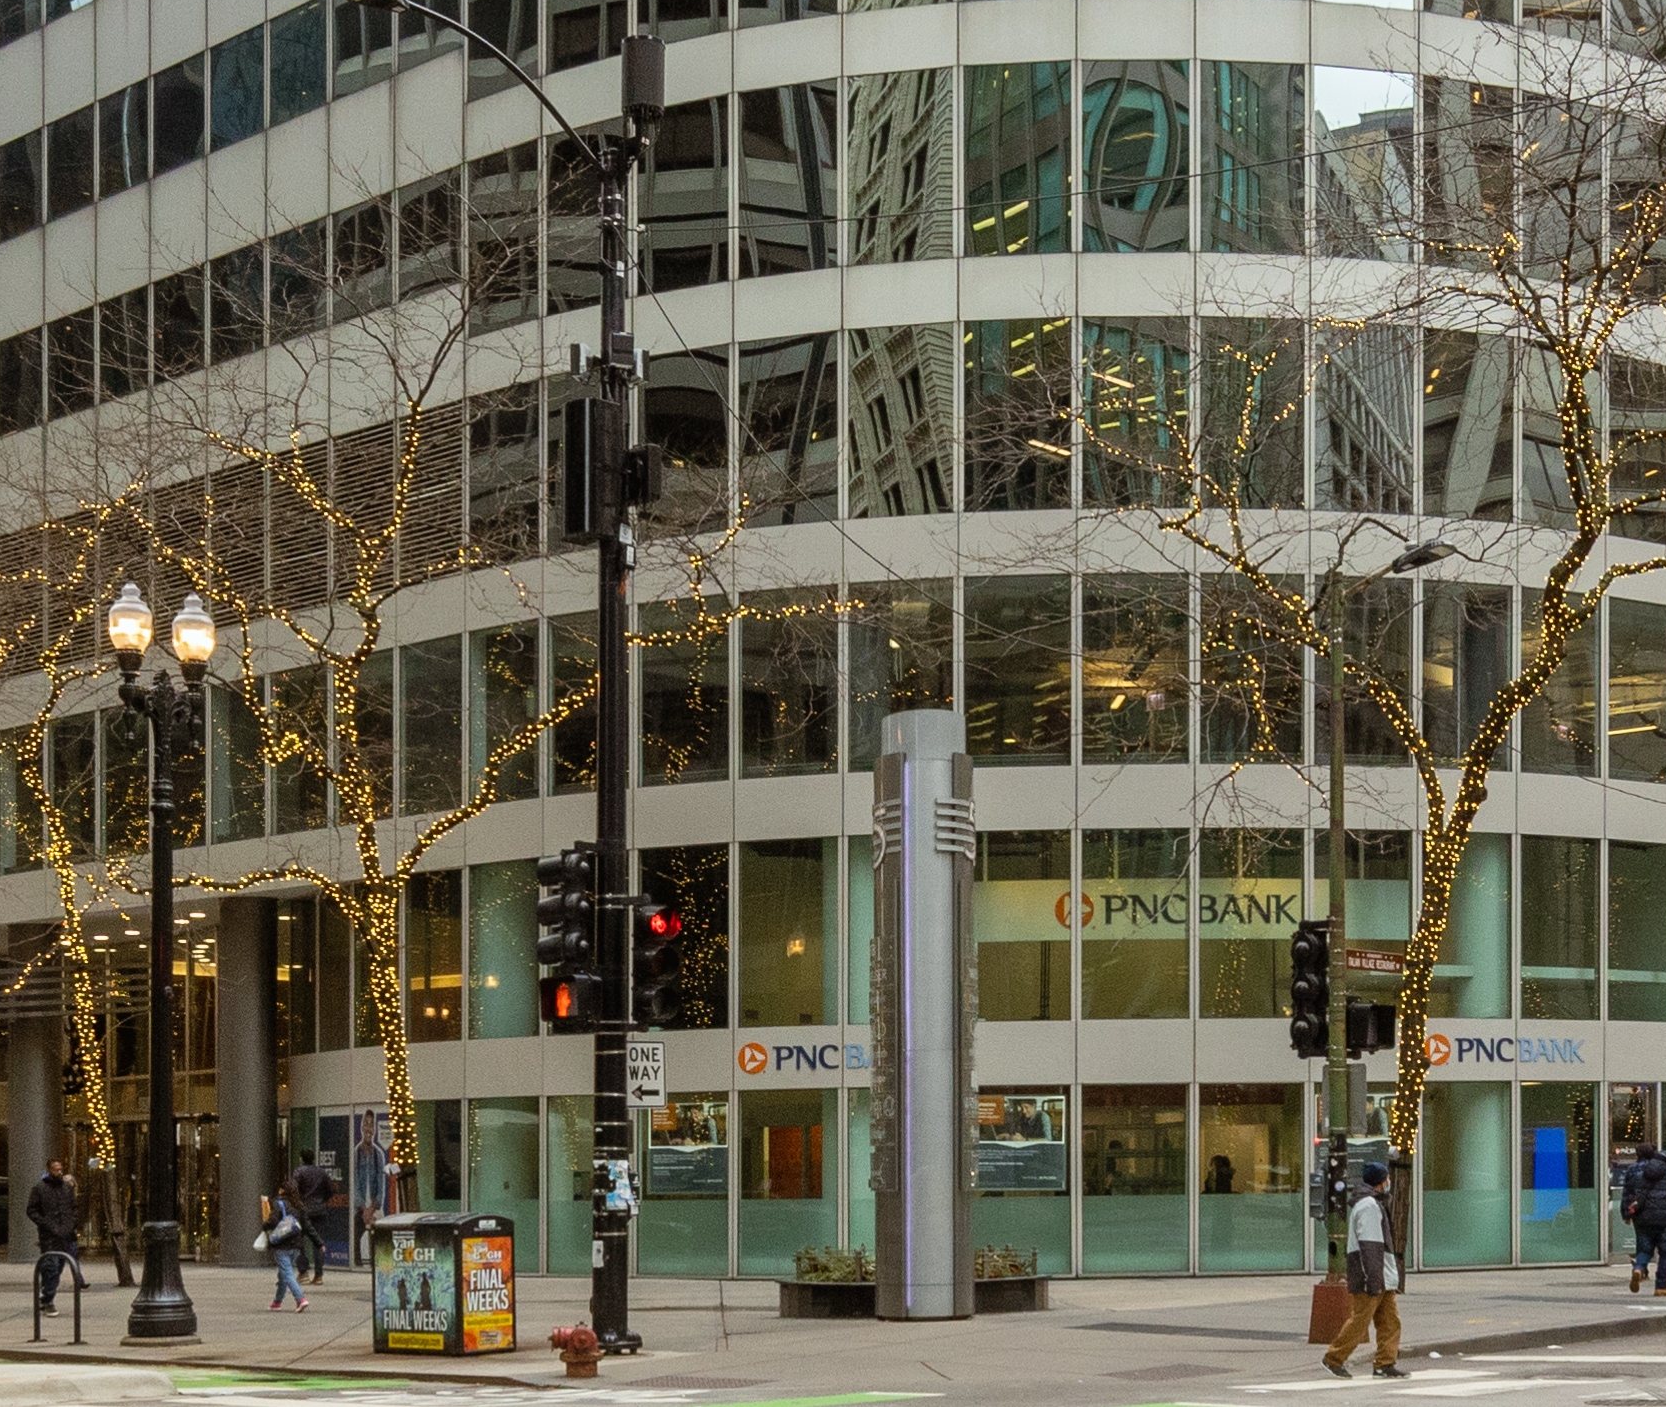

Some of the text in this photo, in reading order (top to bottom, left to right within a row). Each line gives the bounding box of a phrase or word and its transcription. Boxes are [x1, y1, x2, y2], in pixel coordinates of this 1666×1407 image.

[629, 1046, 661, 1063] ONE
[629, 1065, 661, 1081] WAY
[470, 1268, 505, 1290] FINAL
[467, 1289, 509, 1312] WEEKS
[384, 1309, 448, 1331] FINAL WEEKS
